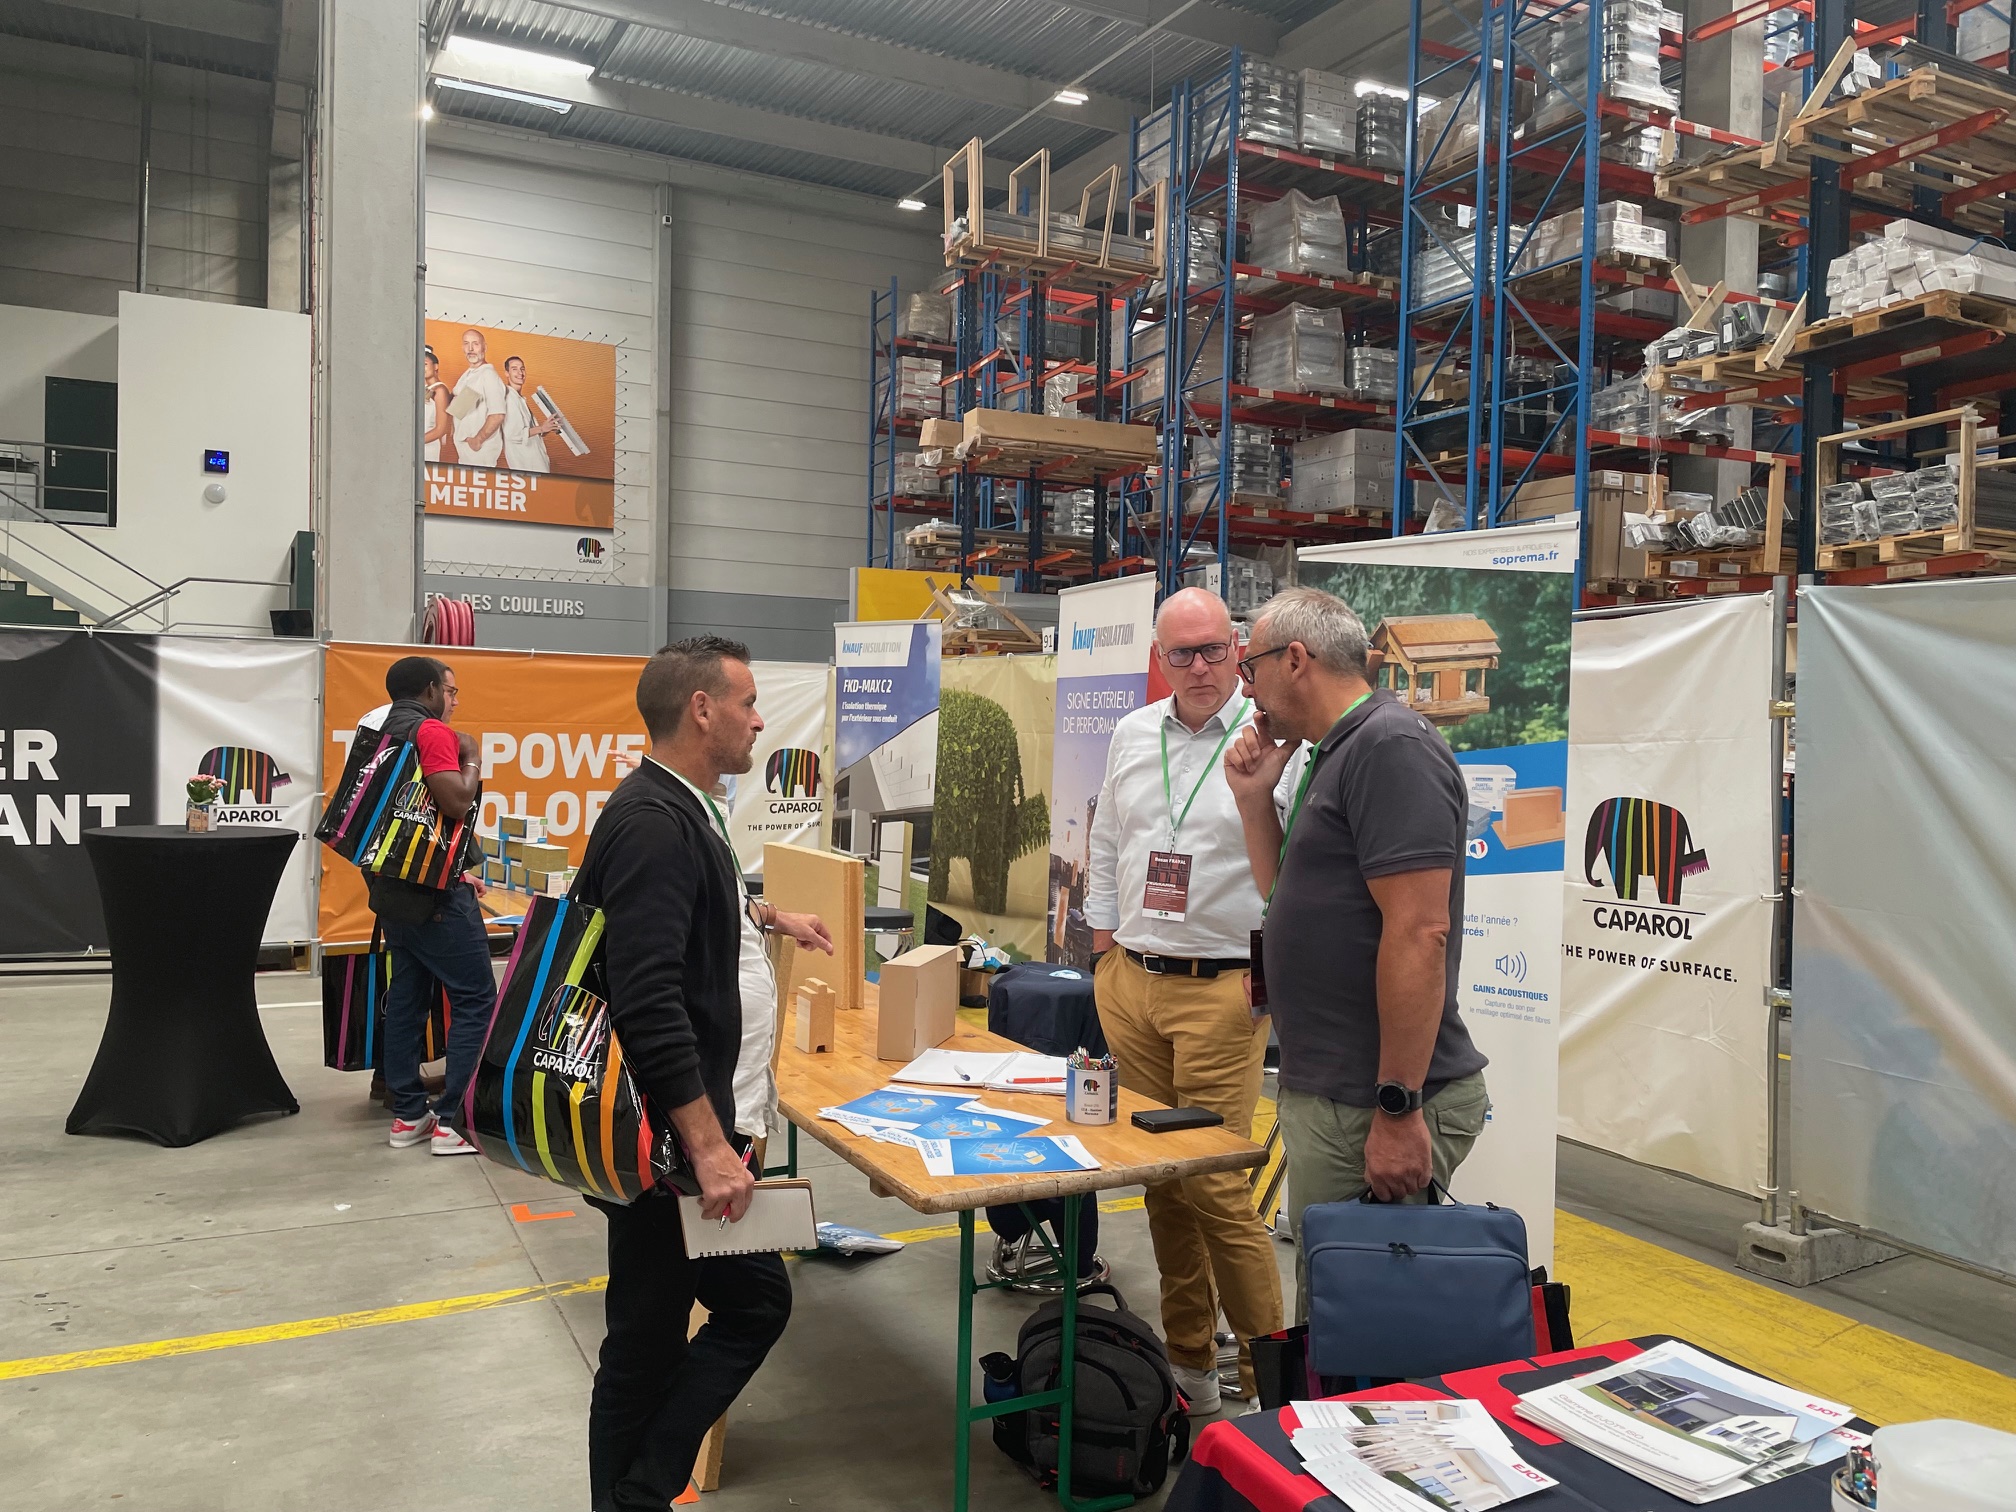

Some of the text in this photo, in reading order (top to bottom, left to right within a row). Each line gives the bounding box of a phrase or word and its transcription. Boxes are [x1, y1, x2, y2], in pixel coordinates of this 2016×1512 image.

[430, 483, 527, 512] METIER
[1492, 551, 1559, 566] soprema.fr
[1210, 574, 1219, 586] 14
[500, 595, 584, 616] COULEURS
[1043, 634, 1053, 649] 91
[1094, 622, 1135, 649] INSULATION
[862, 642, 902, 654] INSULATION
[1067, 686, 1135, 710] SIGNE EXTÉRIEUR
[1063, 717, 1075, 734] DE
[769, 802, 824, 814] CAPAROL
[393, 810, 429, 825] CAPAROL
[765, 823, 793, 831] POWER
[1481, 914, 1511, 926] l'année
[1593, 907, 1693, 941] CAPAROL
[1561, 943, 1738, 983] HE POWER OF SURFACE.
[1473, 984, 1549, 1001] GAINS ACOUSTIQUES
[1484, 999, 1506, 1008] Capture
[1507, 1002, 1515, 1010] du
[1476, 1007, 1499, 1017] maillage
[1523, 1012, 1534, 1022] des
[533, 1051, 595, 1079] CAPAROL
[1559, 1394, 1594, 1416] Gamme
[1806, 1403, 1842, 1418] EJOT
[1511, 1463, 1549, 1483] EJOT
